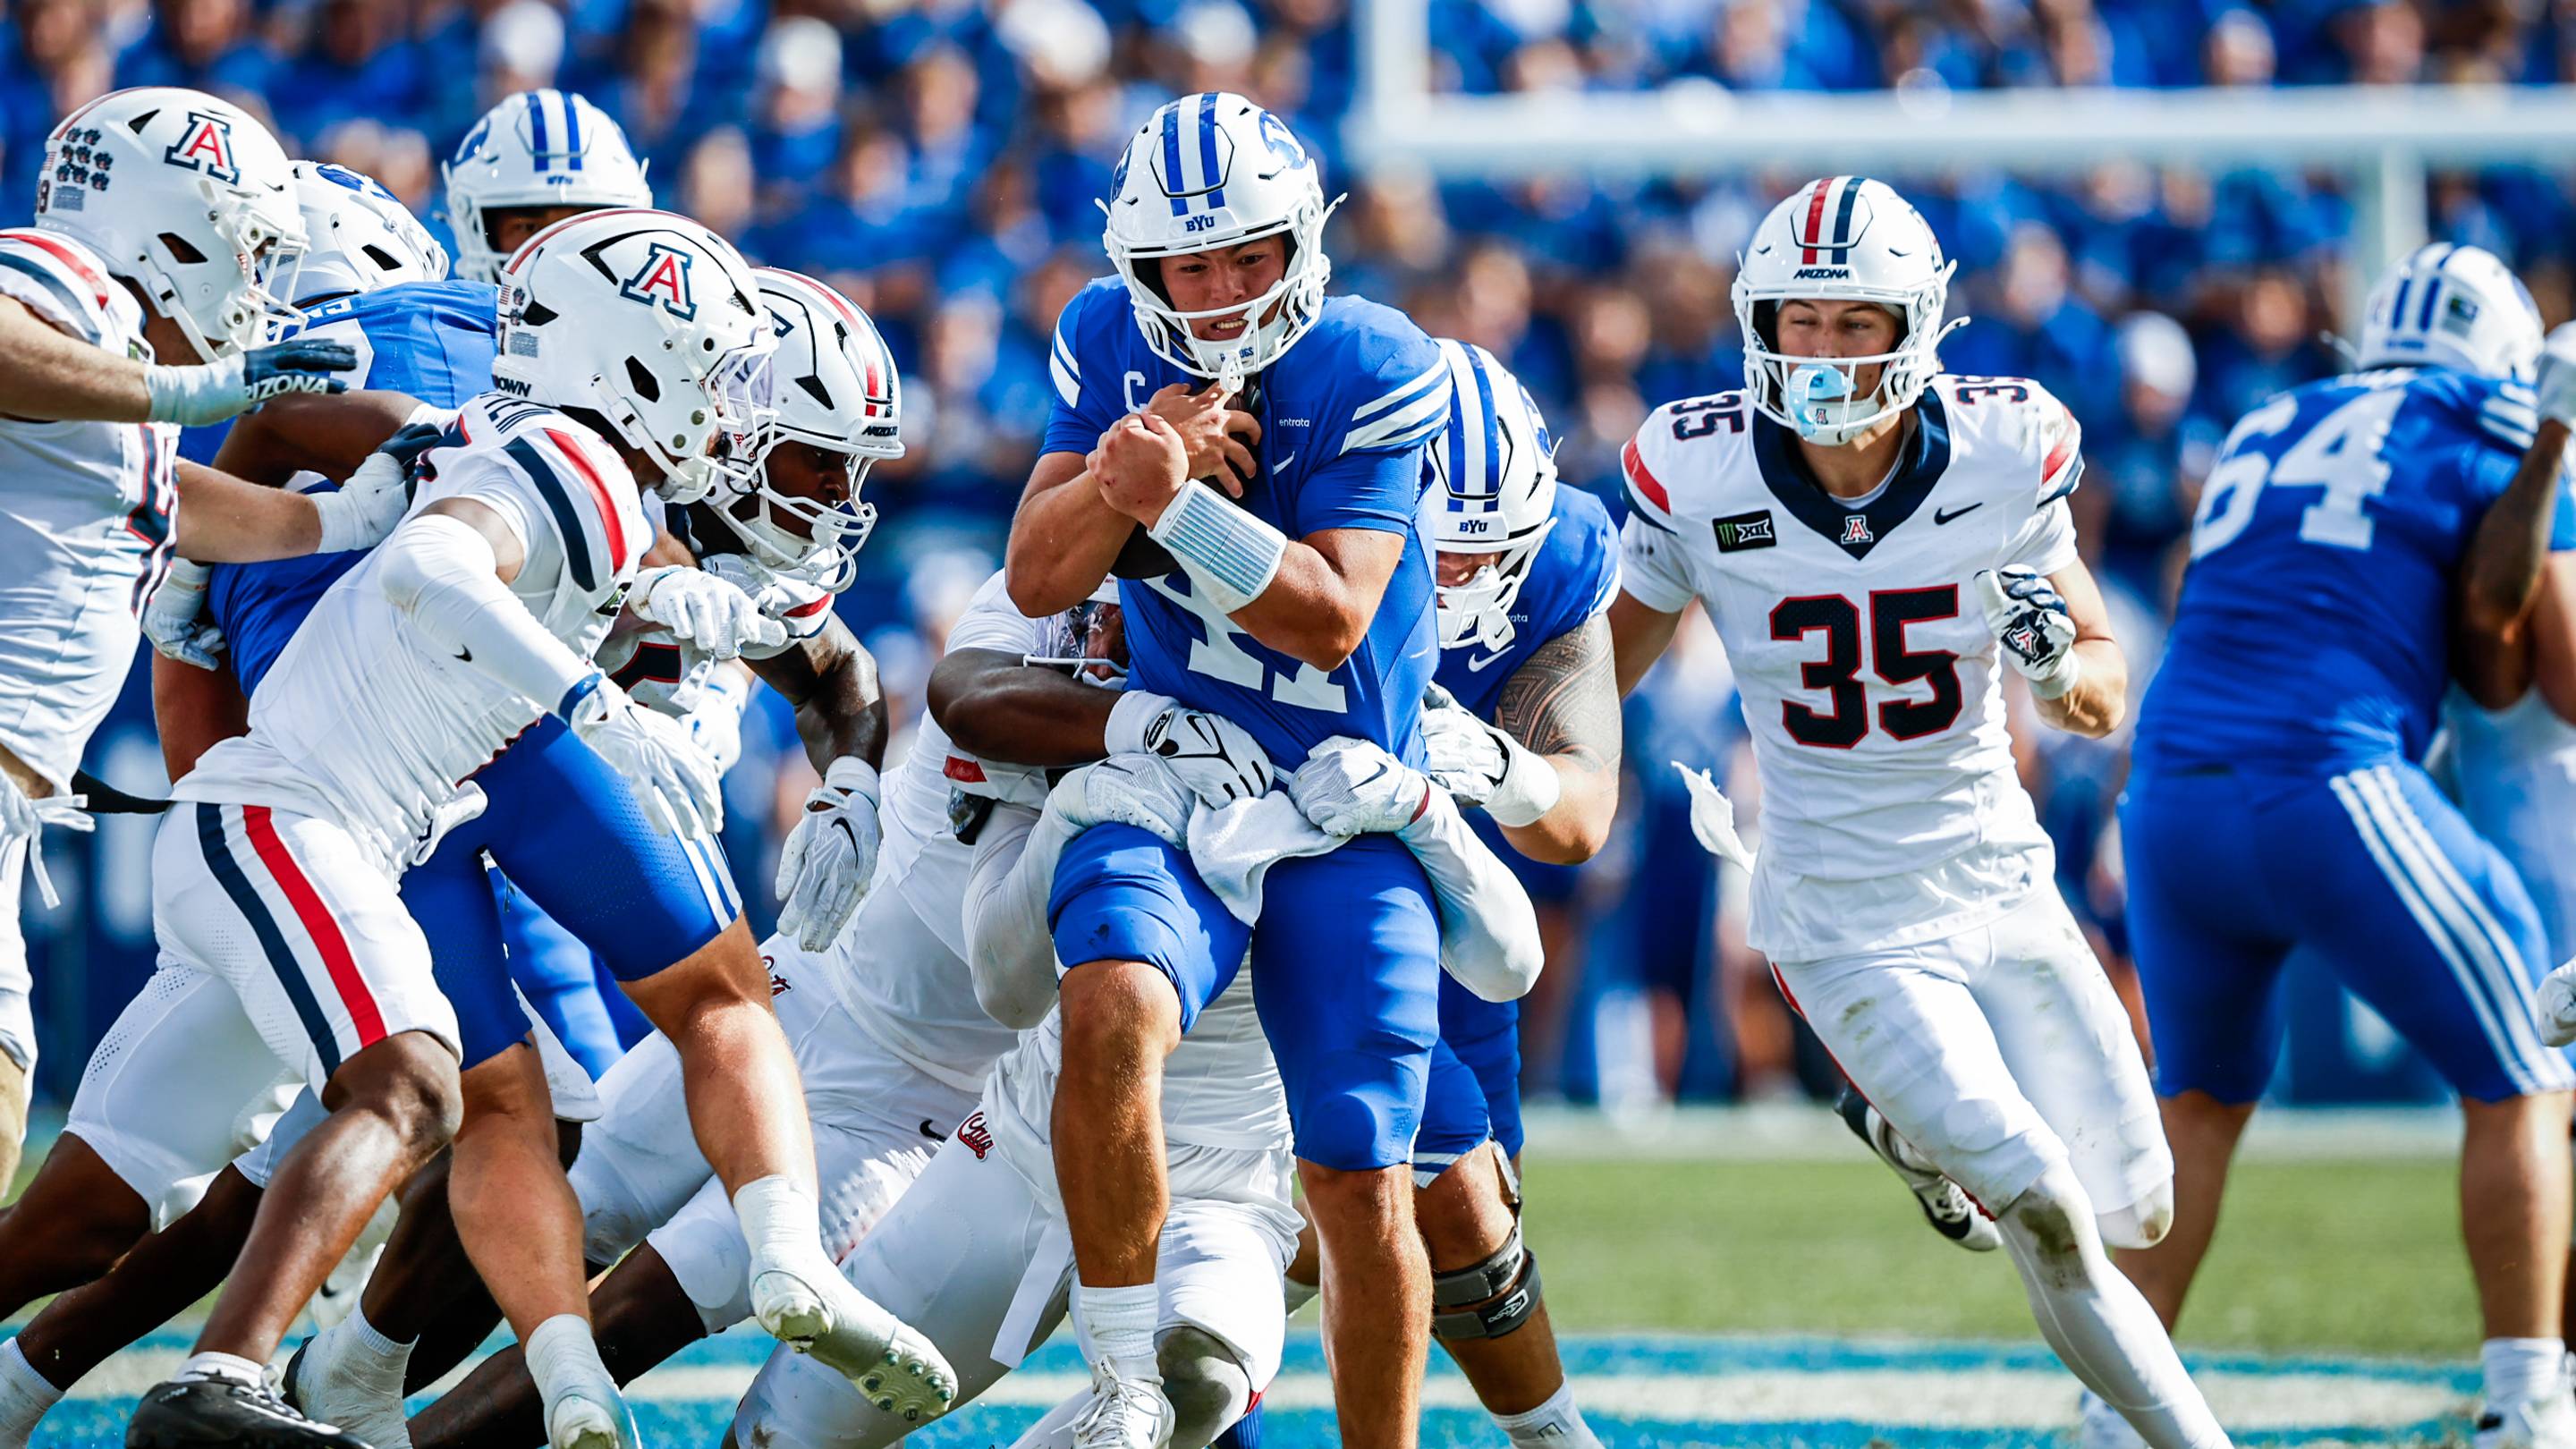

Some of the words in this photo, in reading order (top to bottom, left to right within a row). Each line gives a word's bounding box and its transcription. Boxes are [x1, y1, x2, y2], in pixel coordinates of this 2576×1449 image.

[164, 111, 240, 186] A
[1185, 215, 1215, 233] BYU
[619, 242, 698, 322] A
[1793, 268, 1850, 280] ARIZONA
[1279, 418, 1310, 428] entrata
[1670, 394, 1745, 442] 35
[2190, 387, 2407, 562] 64
[1459, 520, 1488, 534] BYU
[1841, 514, 1874, 545] A
[1768, 582, 1963, 750] 35
